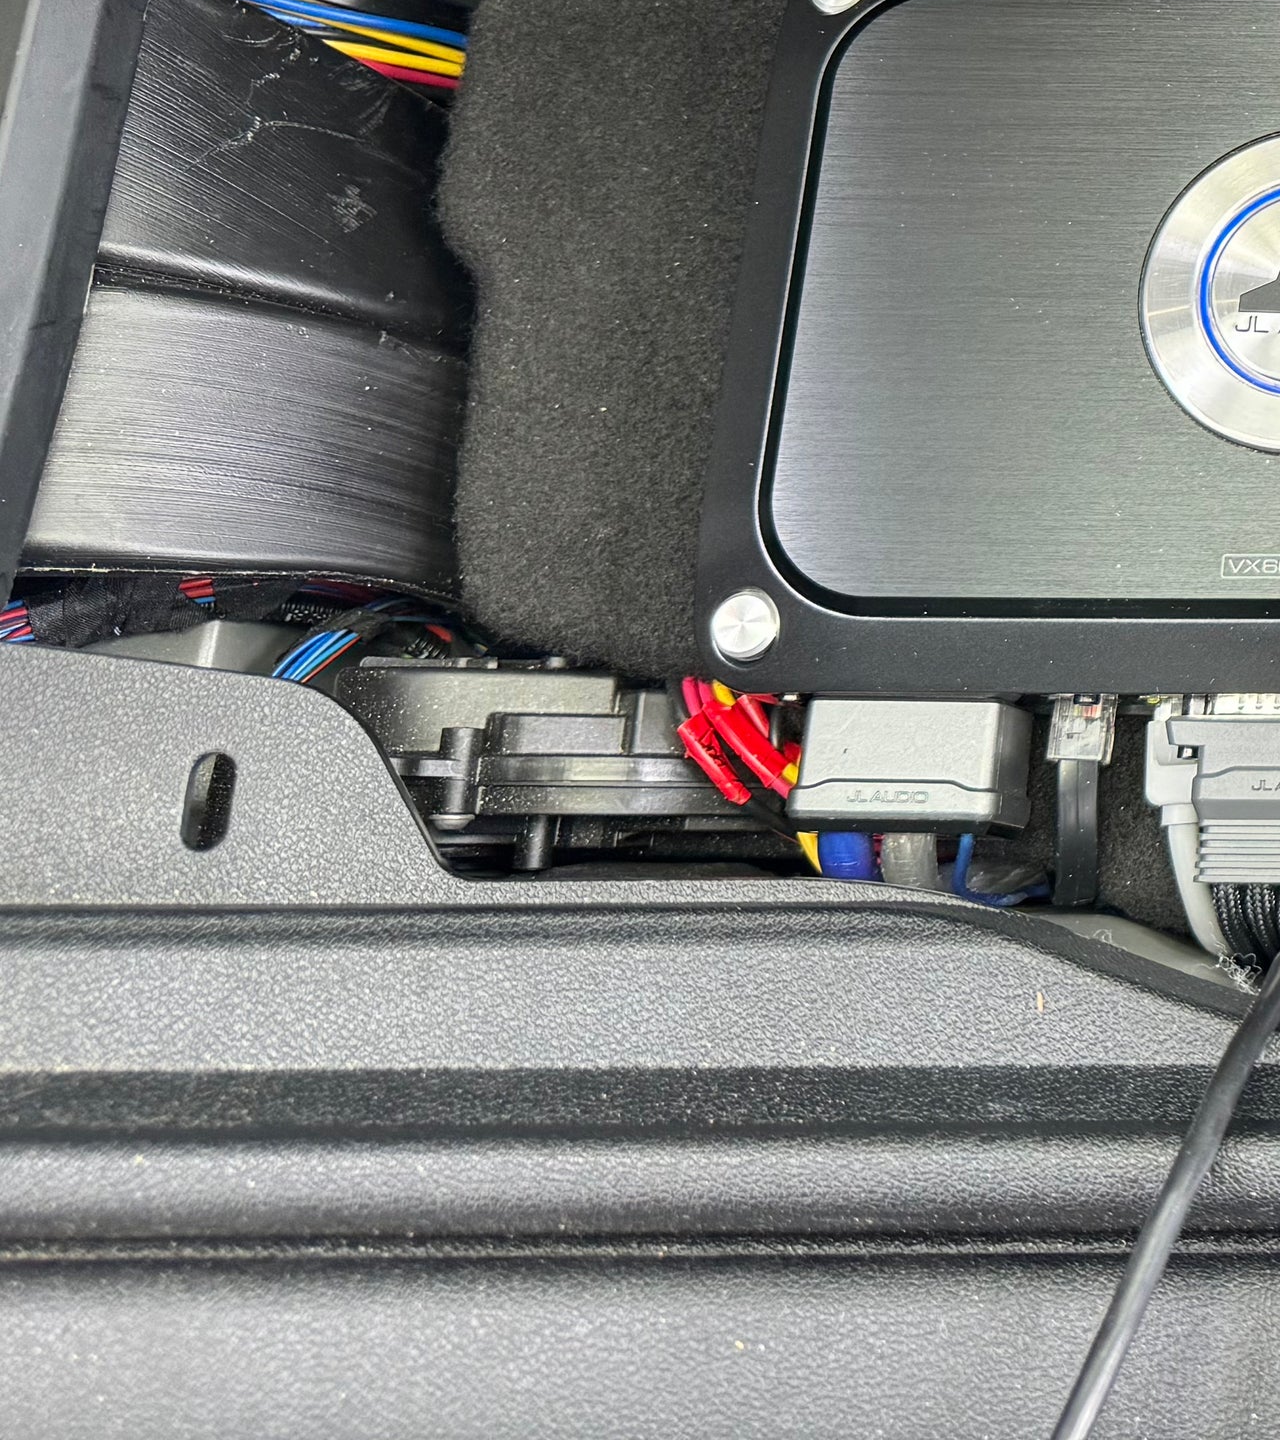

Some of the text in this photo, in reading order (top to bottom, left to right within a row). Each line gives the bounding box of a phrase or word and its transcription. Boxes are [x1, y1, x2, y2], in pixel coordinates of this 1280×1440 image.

[1235, 315, 1269, 333] JL
[1251, 779, 1272, 791] JL
[846, 789, 929, 804] JL AUDIO
